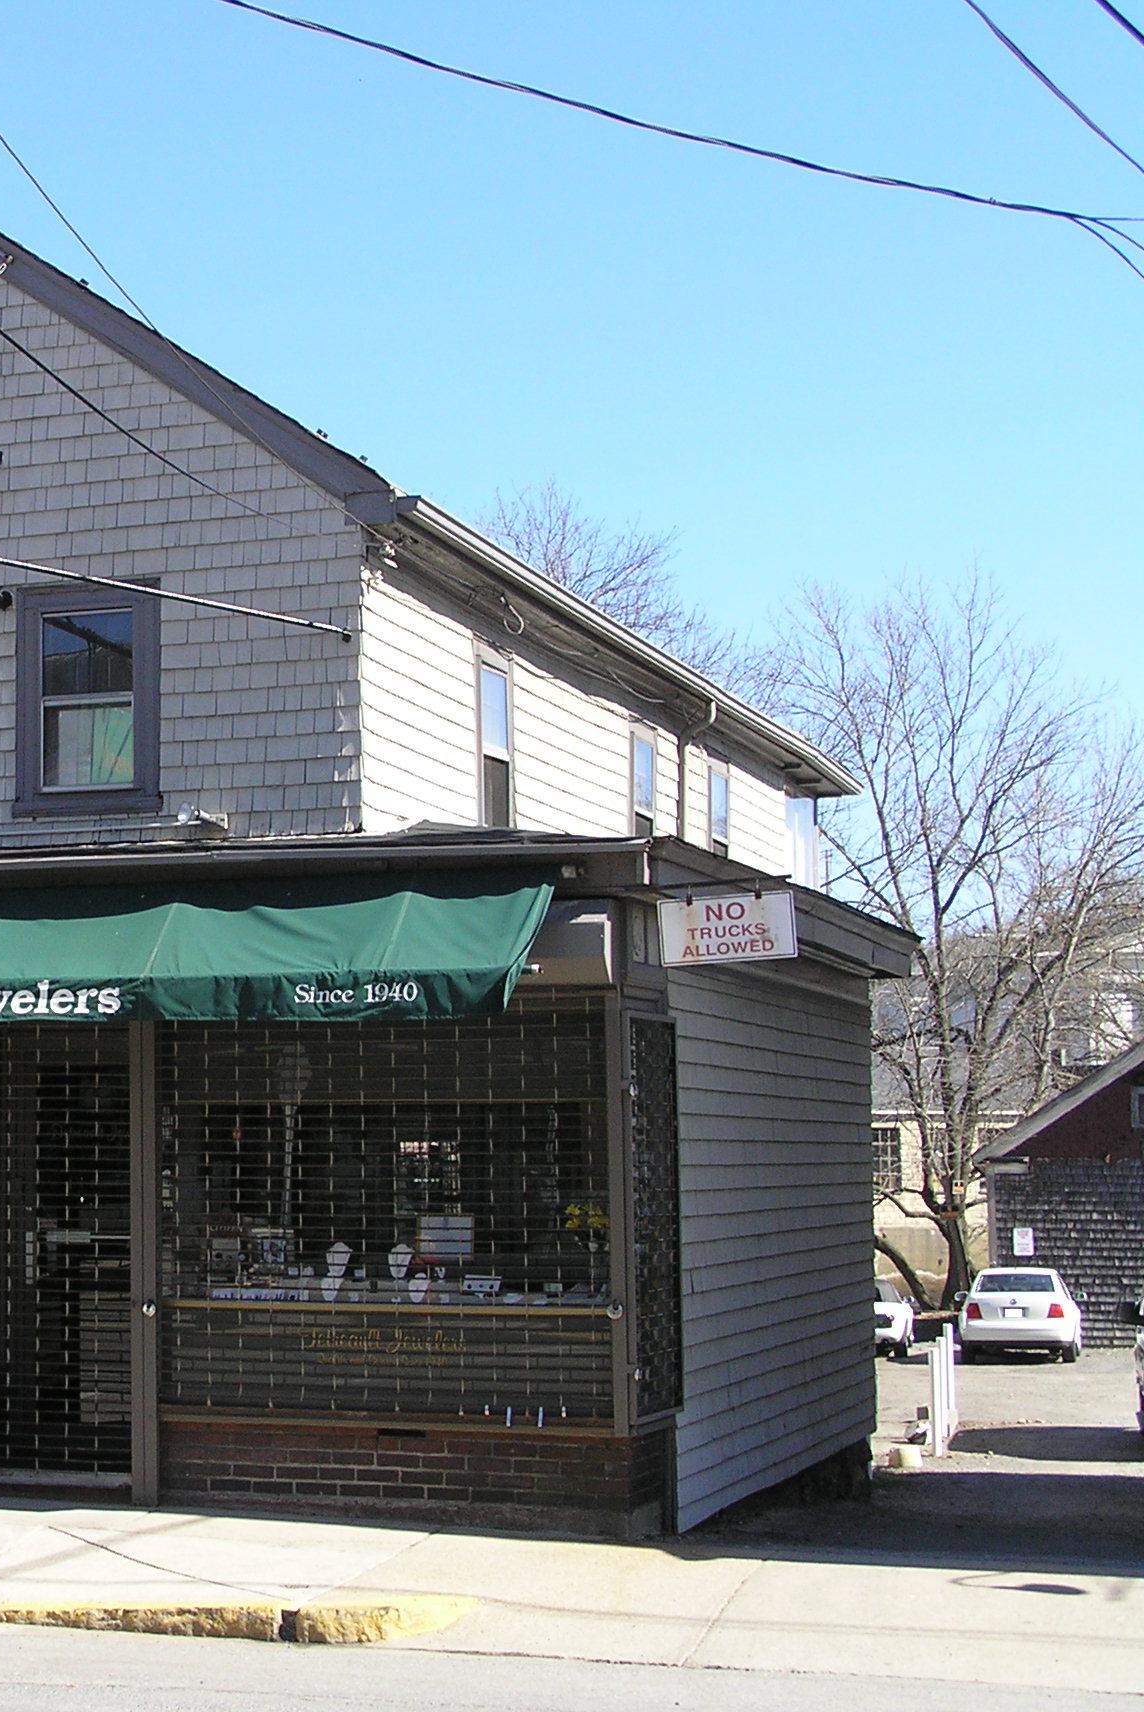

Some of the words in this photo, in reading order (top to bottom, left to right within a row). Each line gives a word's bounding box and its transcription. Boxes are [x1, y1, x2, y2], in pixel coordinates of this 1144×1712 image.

[704, 902, 746, 922] NO
[687, 922, 768, 941] TRUCKS
[682, 940, 775, 958] ALLOWED
[294, 983, 355, 1004] Since
[363, 981, 419, 1003] 1940
